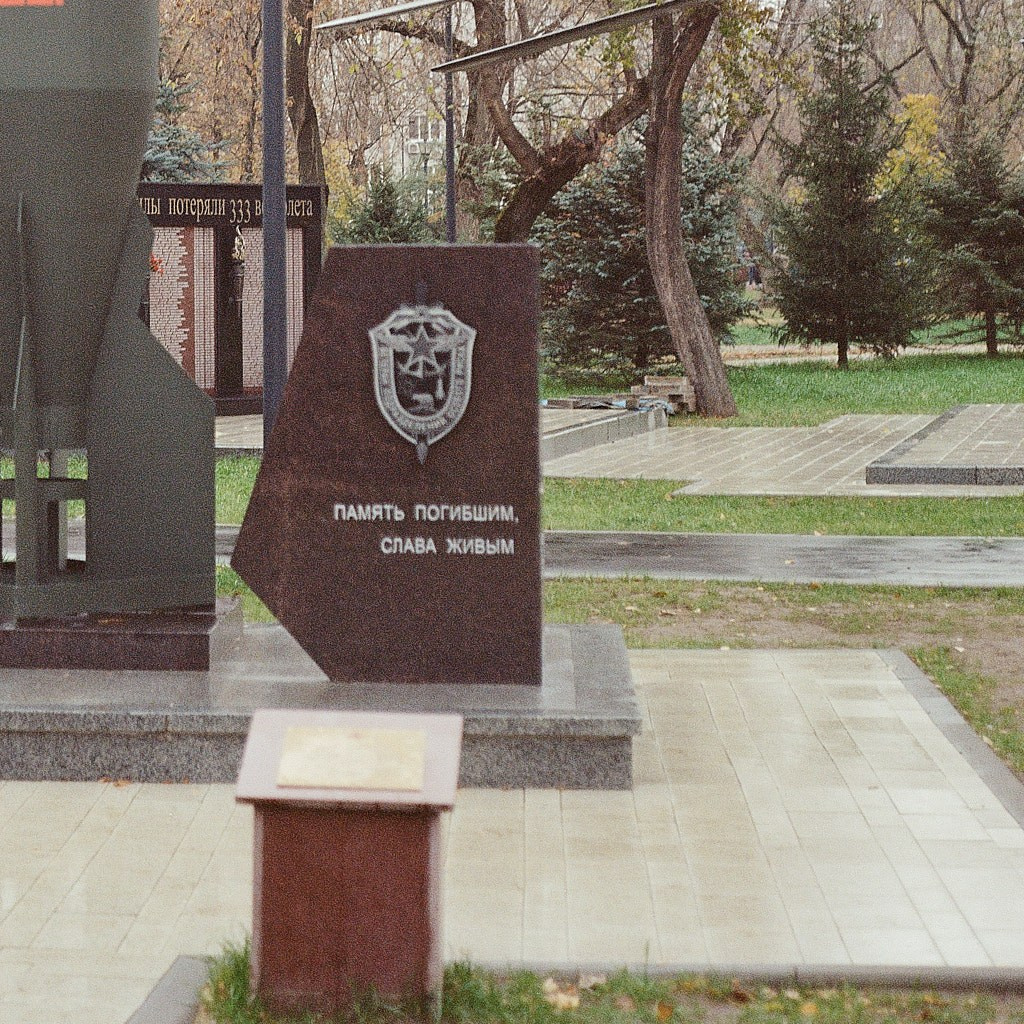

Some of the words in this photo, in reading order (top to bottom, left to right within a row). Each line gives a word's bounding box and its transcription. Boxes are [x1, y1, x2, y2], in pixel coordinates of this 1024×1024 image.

[168, 197, 226, 223] потеряли
[229, 199, 251, 223] 333
[333, 503, 405, 522] ПАМЯТЬ
[414, 504, 520, 523] ПОГИБШИМ,
[380, 536, 437, 555] СЛАВА
[446, 537, 515, 555] ЖИВЫМ
